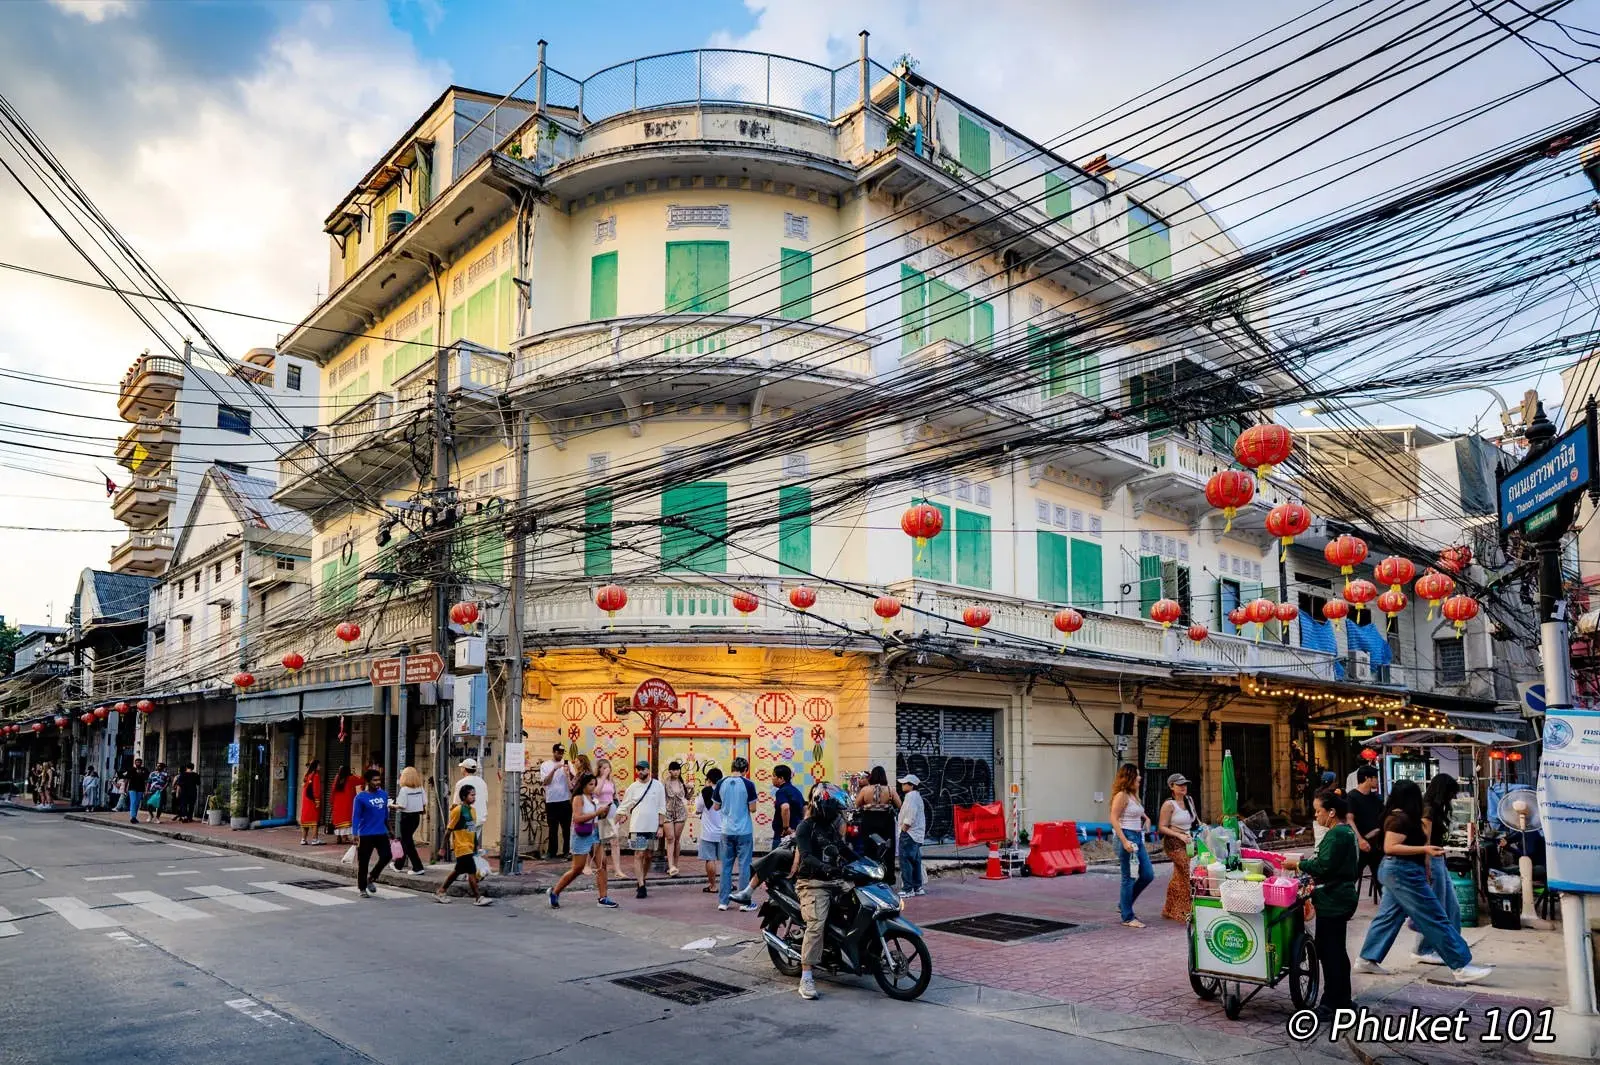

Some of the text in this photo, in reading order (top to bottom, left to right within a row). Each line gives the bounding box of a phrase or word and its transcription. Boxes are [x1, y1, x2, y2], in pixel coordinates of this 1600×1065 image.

[1508, 443, 1576, 503] ถนนเยาวพานิช
[1516, 498, 1535, 514] Thanon
